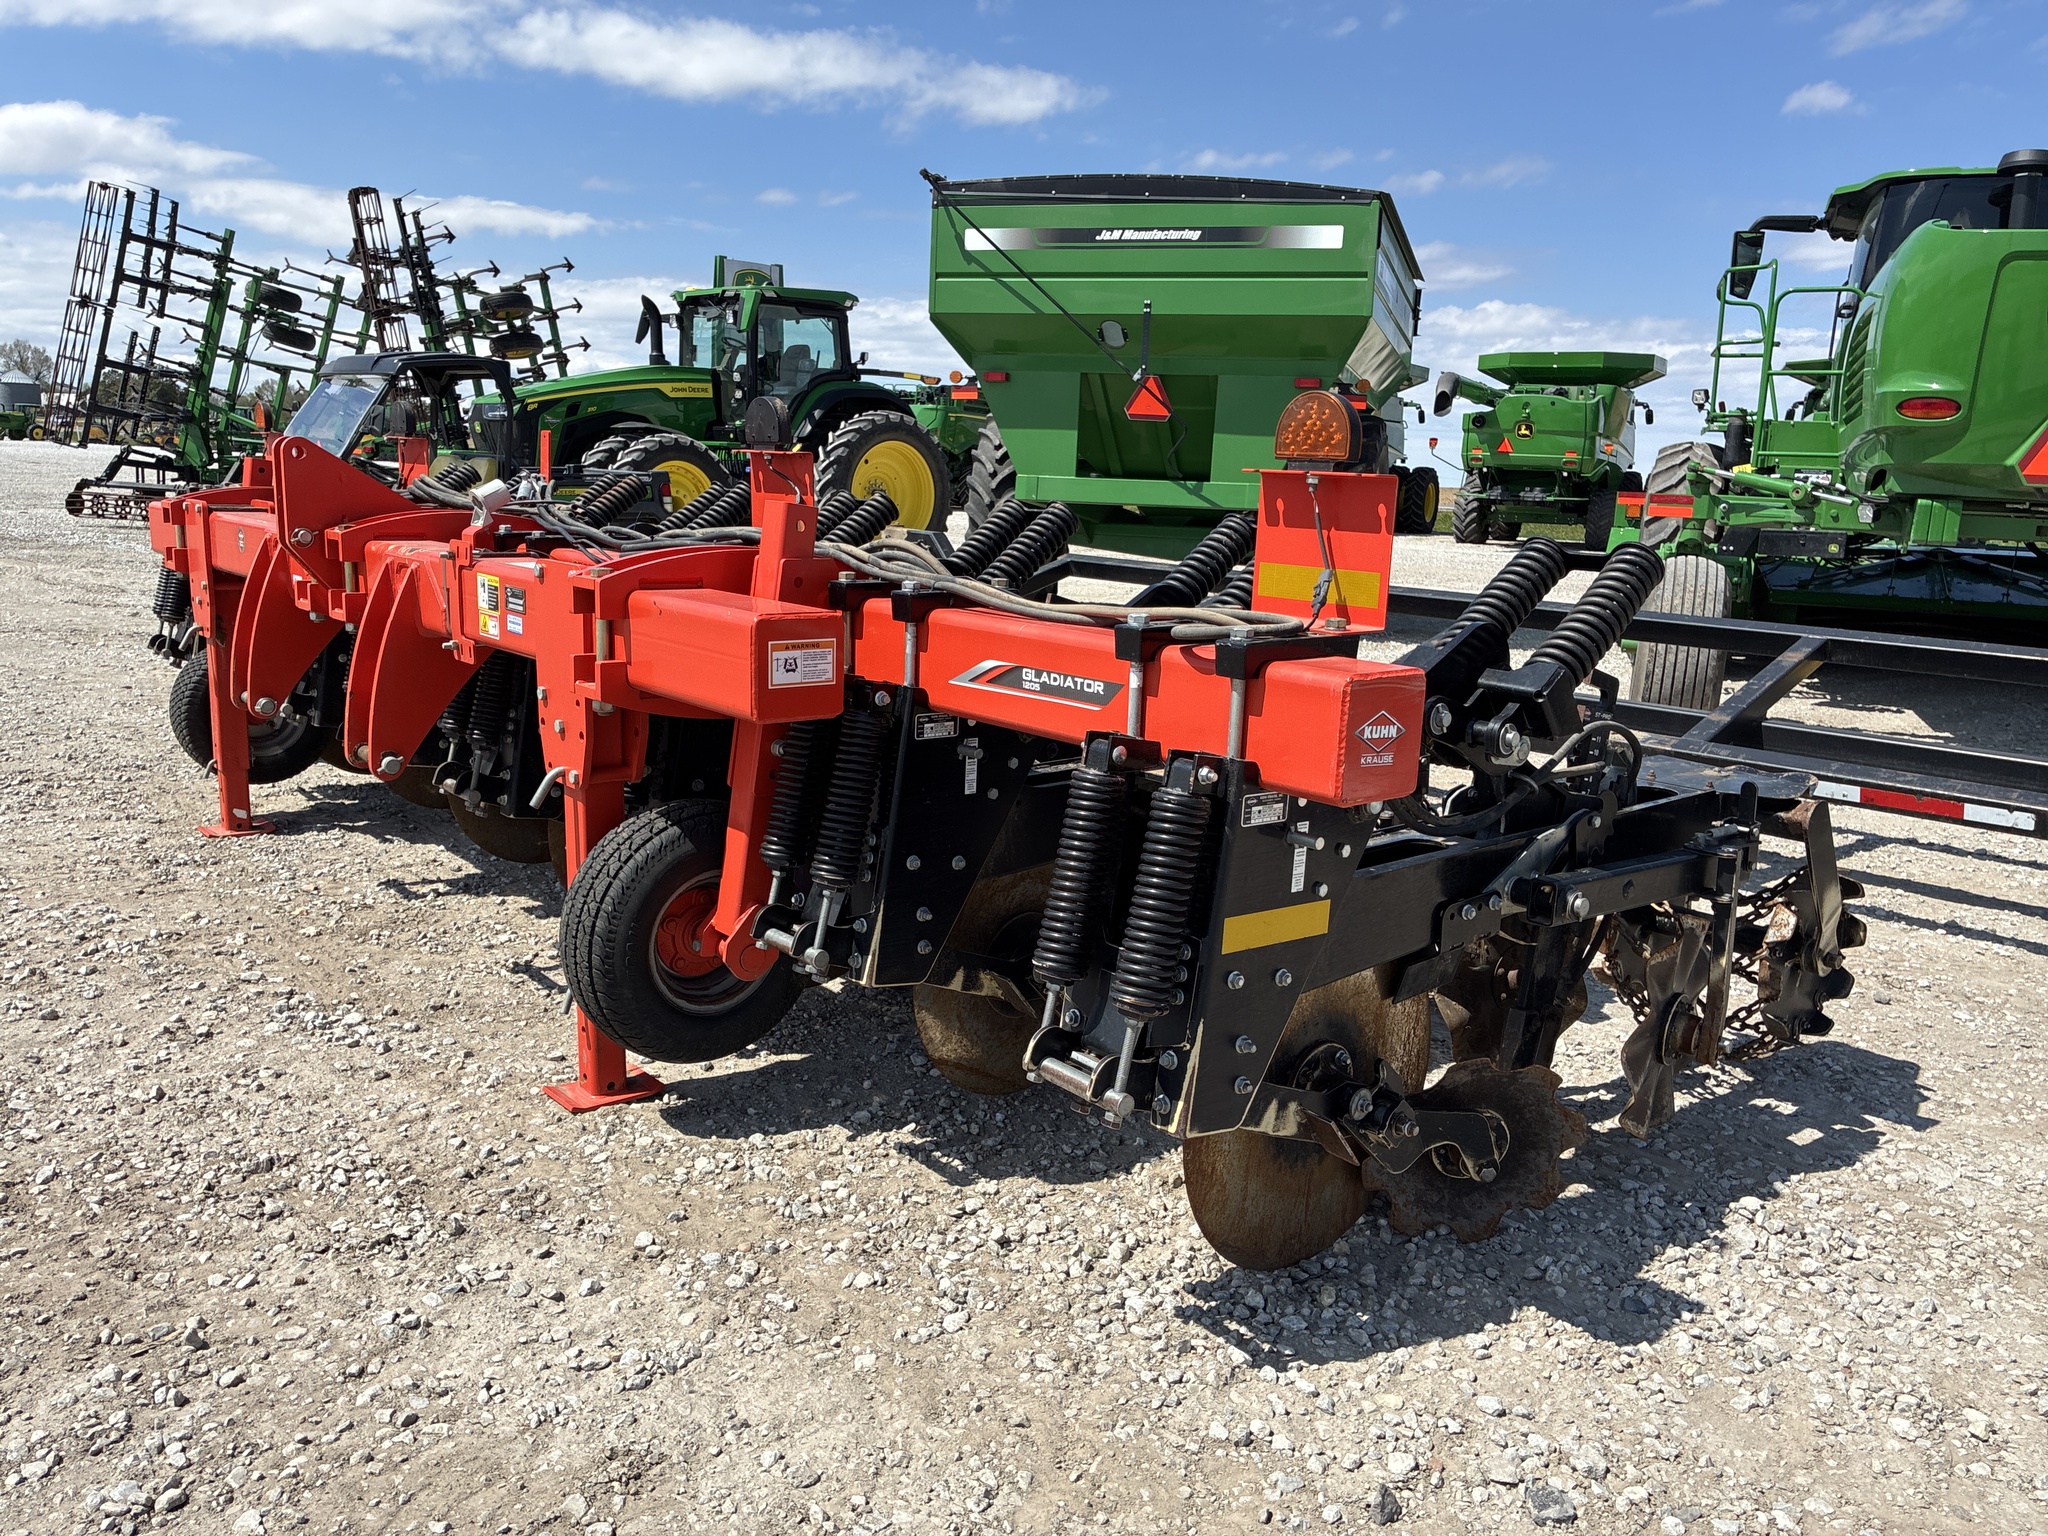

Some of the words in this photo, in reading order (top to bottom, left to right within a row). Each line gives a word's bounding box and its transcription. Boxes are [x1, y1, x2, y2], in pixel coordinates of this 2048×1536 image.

[1095, 229, 1123, 241] J&M
[1121, 229, 1202, 241] Manufacturing
[669, 386, 687, 394] JOHN
[688, 386, 709, 394] DEERE
[527, 403, 538, 412] 8R
[1022, 668, 1105, 695] GLADIATOR
[1022, 681, 1041, 692] 1205
[1364, 725, 1397, 739] KUHN
[1360, 755, 1394, 765] KRAUSE
